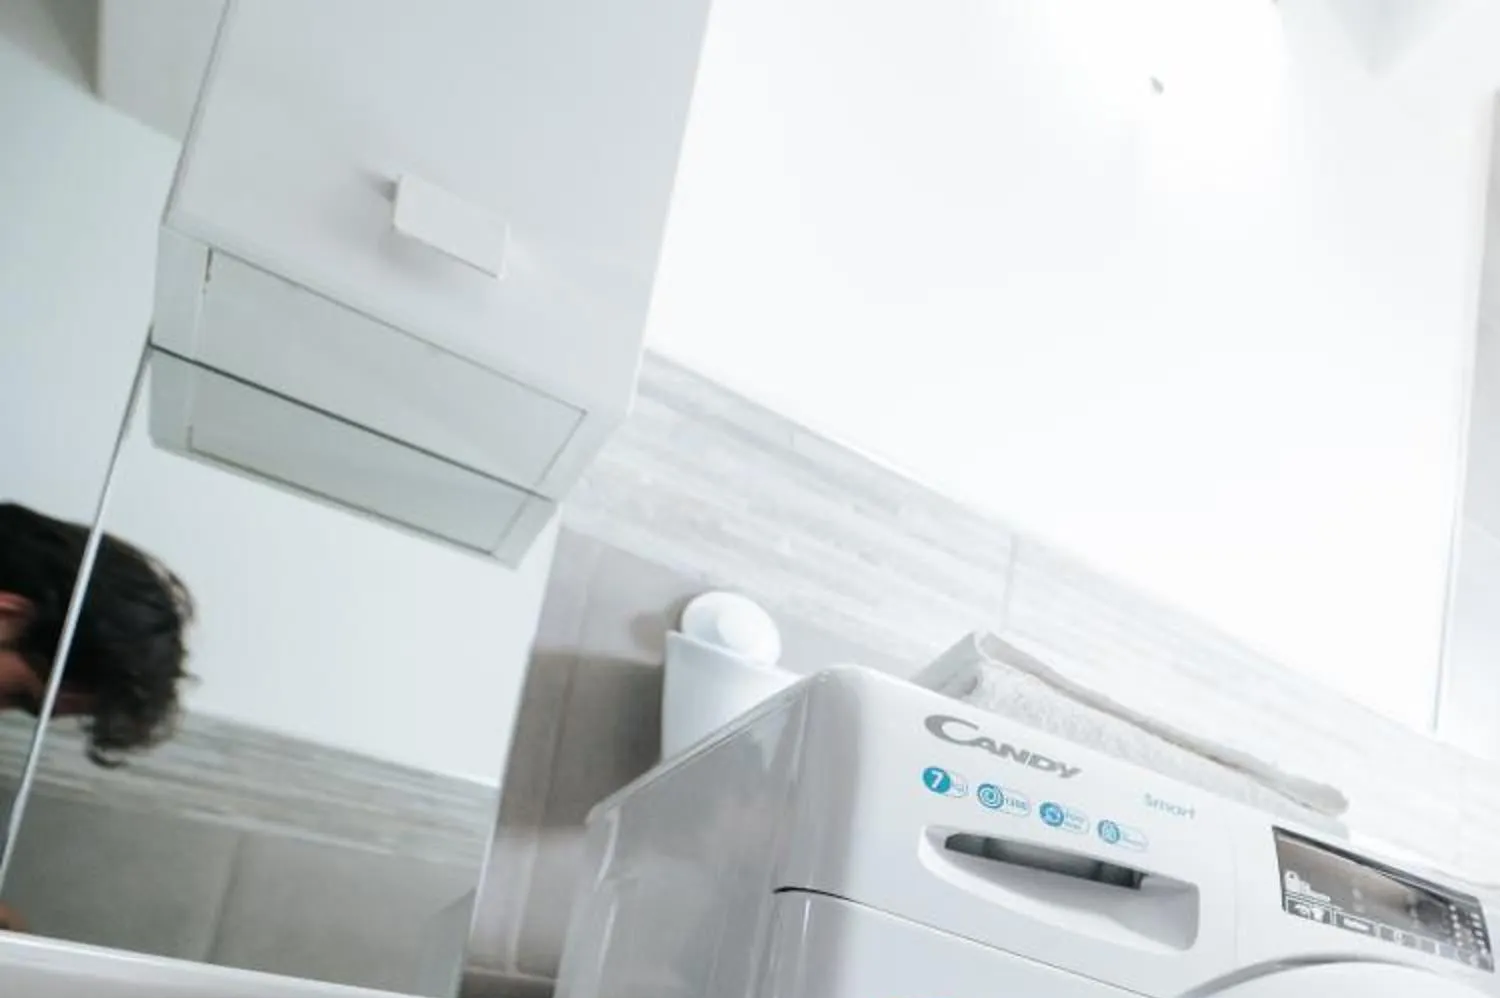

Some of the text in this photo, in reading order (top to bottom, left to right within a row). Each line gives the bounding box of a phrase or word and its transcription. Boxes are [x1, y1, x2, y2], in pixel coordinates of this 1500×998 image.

[924, 714, 1082, 778] CANDY
[930, 770, 944, 788] 7
[1143, 793, 1196, 820] Smart
